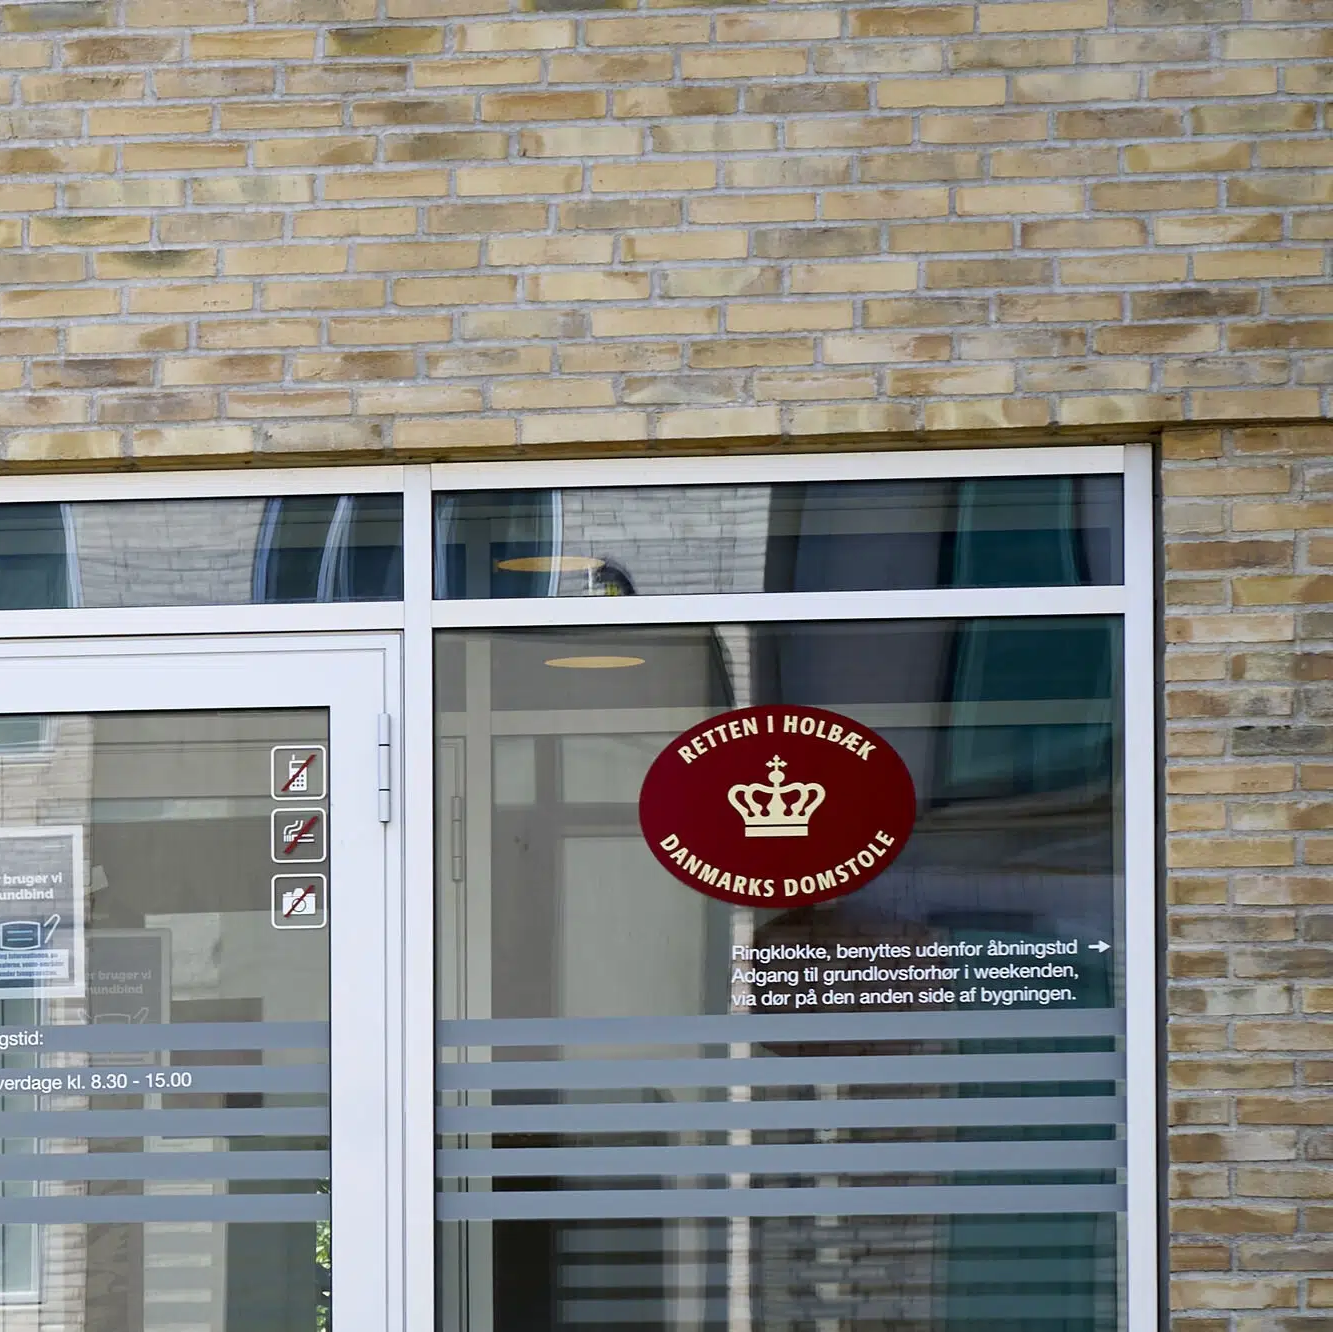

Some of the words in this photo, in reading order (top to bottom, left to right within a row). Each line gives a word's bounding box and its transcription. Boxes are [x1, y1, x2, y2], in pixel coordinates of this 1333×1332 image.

[678, 717, 759, 765] RETTEN
[767, 716, 774, 733] I
[783, 715, 877, 761] HOLBÆK
[659, 833, 775, 897] DANMARKS
[783, 829, 895, 897] DOMSTOLE
[3, 873, 48, 886] bruger
[51, 872, 62, 883] vi
[732, 944, 831, 964] Ringklokke,
[836, 943, 911, 962] benyttes
[915, 941, 983, 957] udenfor
[987, 939, 1078, 959] åbningstid
[731, 967, 799, 987] Adgang
[803, 967, 818, 982] til
[823, 965, 960, 986] grundlovsforhør
[964, 964, 969, 979] i
[973, 962, 1079, 980] weekenden,
[732, 992, 757, 1006] via
[761, 991, 791, 1006] dør
[795, 989, 817, 1008] på
[822, 990, 855, 1005] den
[859, 989, 914, 1004] anden
[918, 988, 955, 1003] side
[959, 987, 976, 1002] af
[980, 986, 1077, 1006] bygningen.
[67, 1073, 86, 1089] kl.
[90, 1072, 128, 1089] 8.30
[145, 1071, 192, 1088] 15.00
